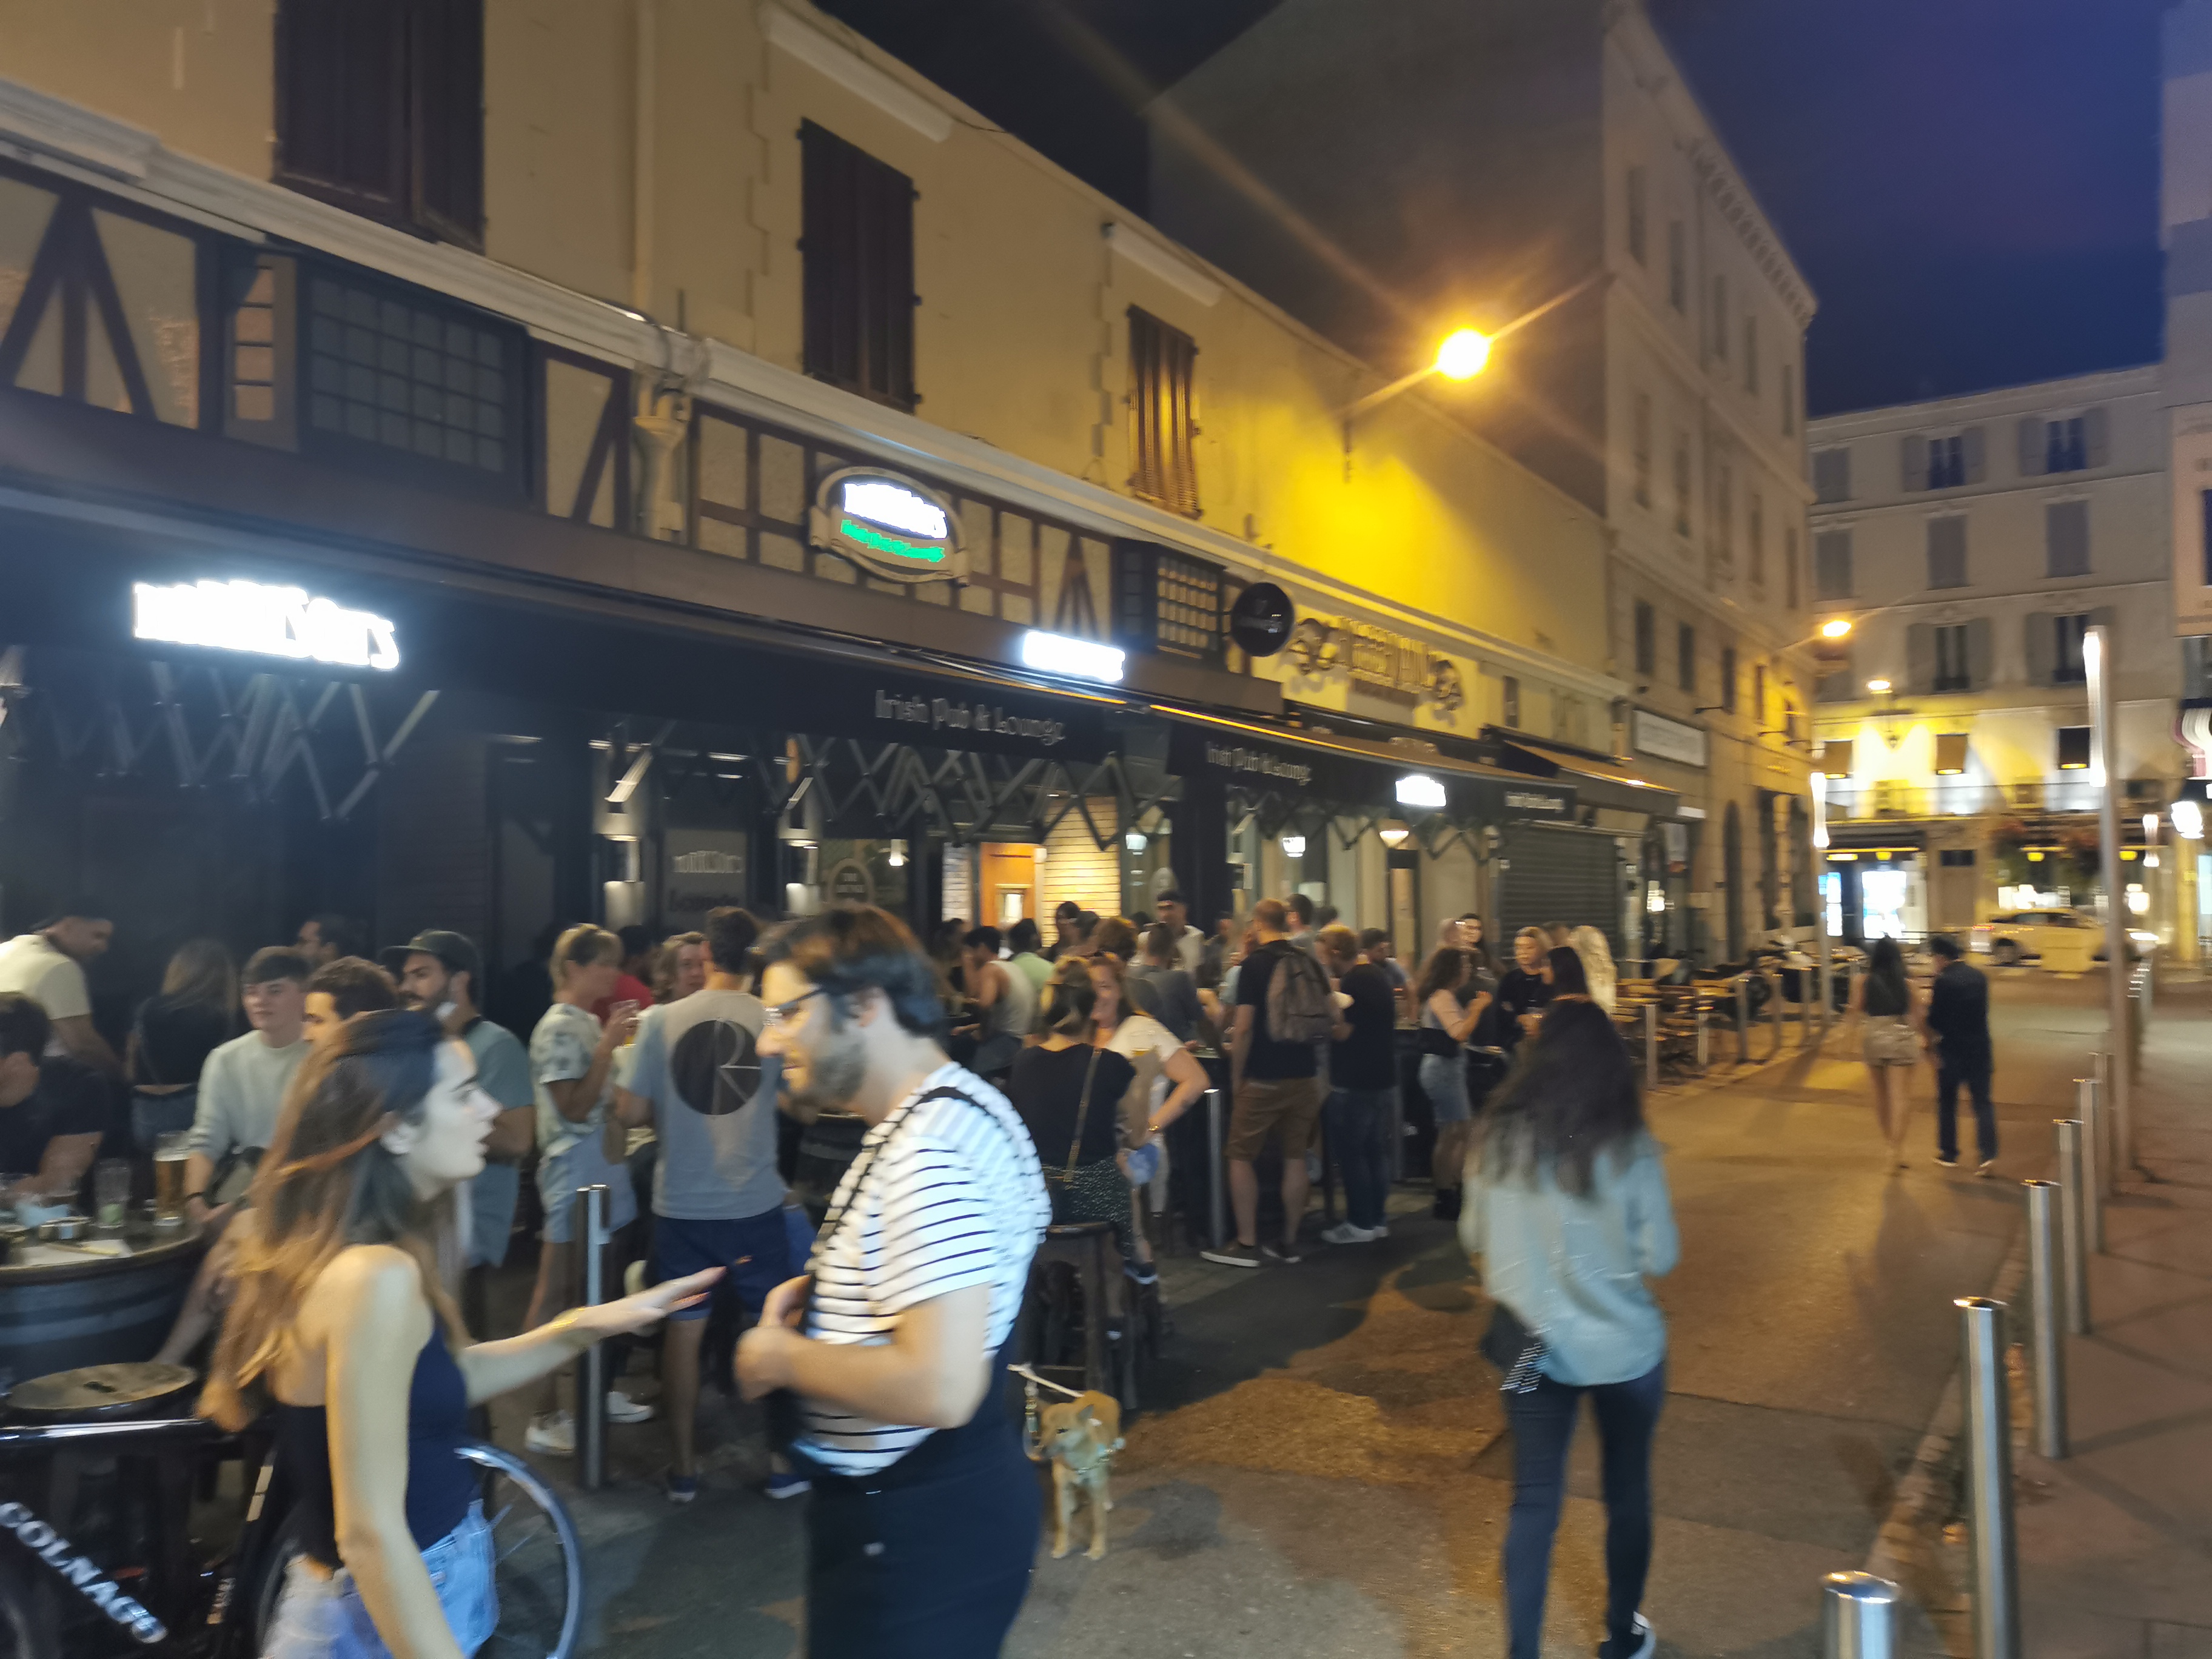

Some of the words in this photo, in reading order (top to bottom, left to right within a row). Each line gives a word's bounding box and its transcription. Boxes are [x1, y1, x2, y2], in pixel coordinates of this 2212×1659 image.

[876, 689, 928, 723] Irish
[932, 697, 970, 730] Pub
[994, 706, 1065, 746] Lounge
[0, 1501, 169, 1644] COLNAGO
